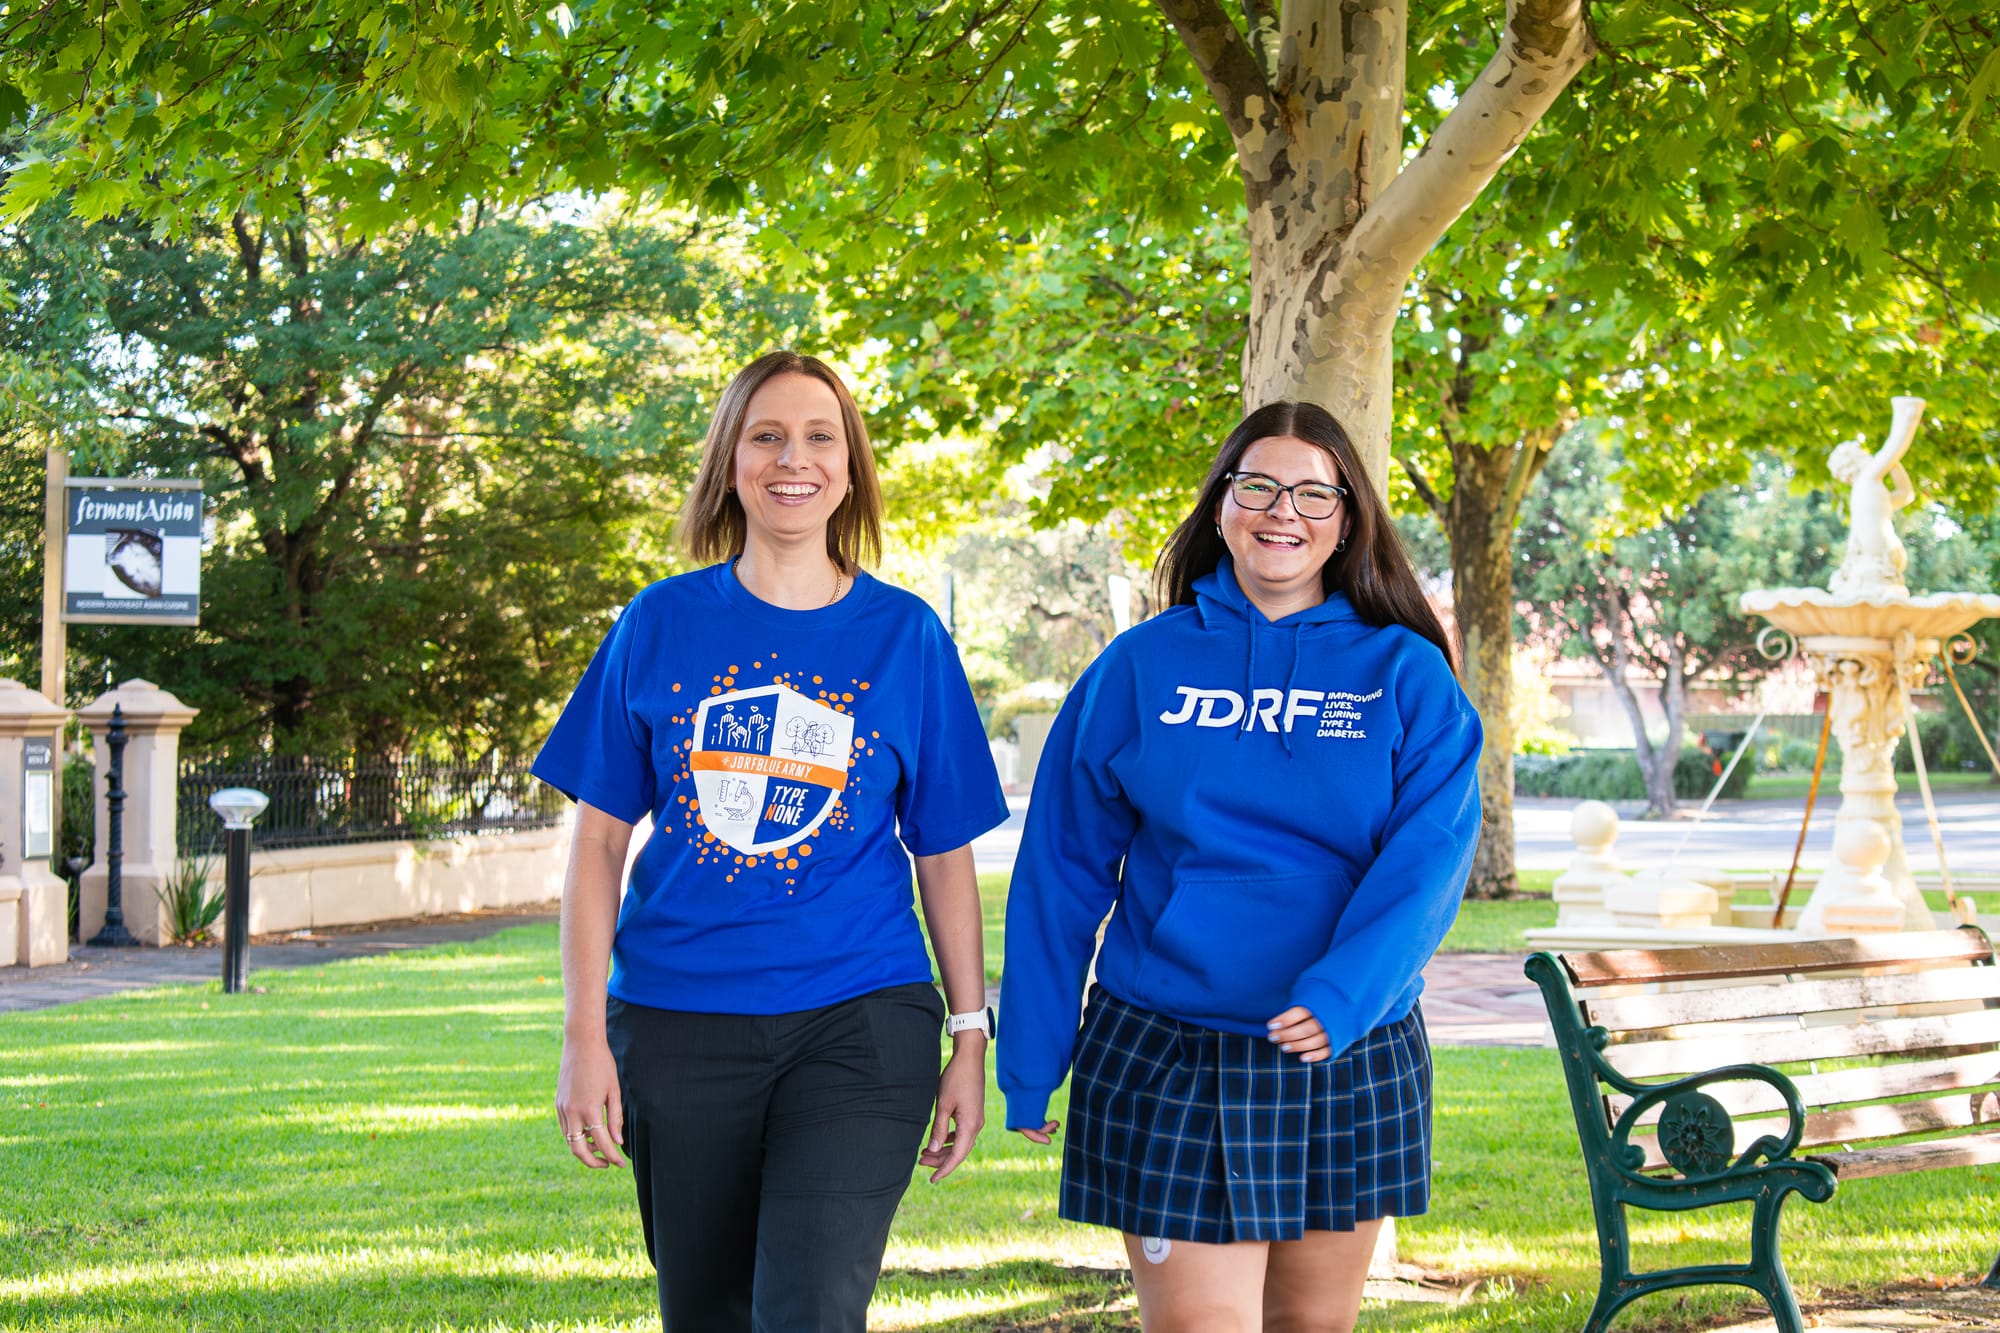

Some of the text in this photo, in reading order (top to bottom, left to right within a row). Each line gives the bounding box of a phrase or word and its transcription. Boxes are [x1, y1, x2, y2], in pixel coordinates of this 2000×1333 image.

[75, 496, 194, 525] fermentAsian
[1327, 688, 1383, 703] IMPROVING
[1159, 686, 1325, 733] JDRF
[1324, 701, 1354, 710] LIVES.
[1322, 710, 1362, 720] CURING
[1320, 720, 1353, 729] TYPE 1
[1316, 729, 1367, 739] DIABETES.
[772, 786, 809, 806] TYPE
[763, 803, 804, 826] NONE
